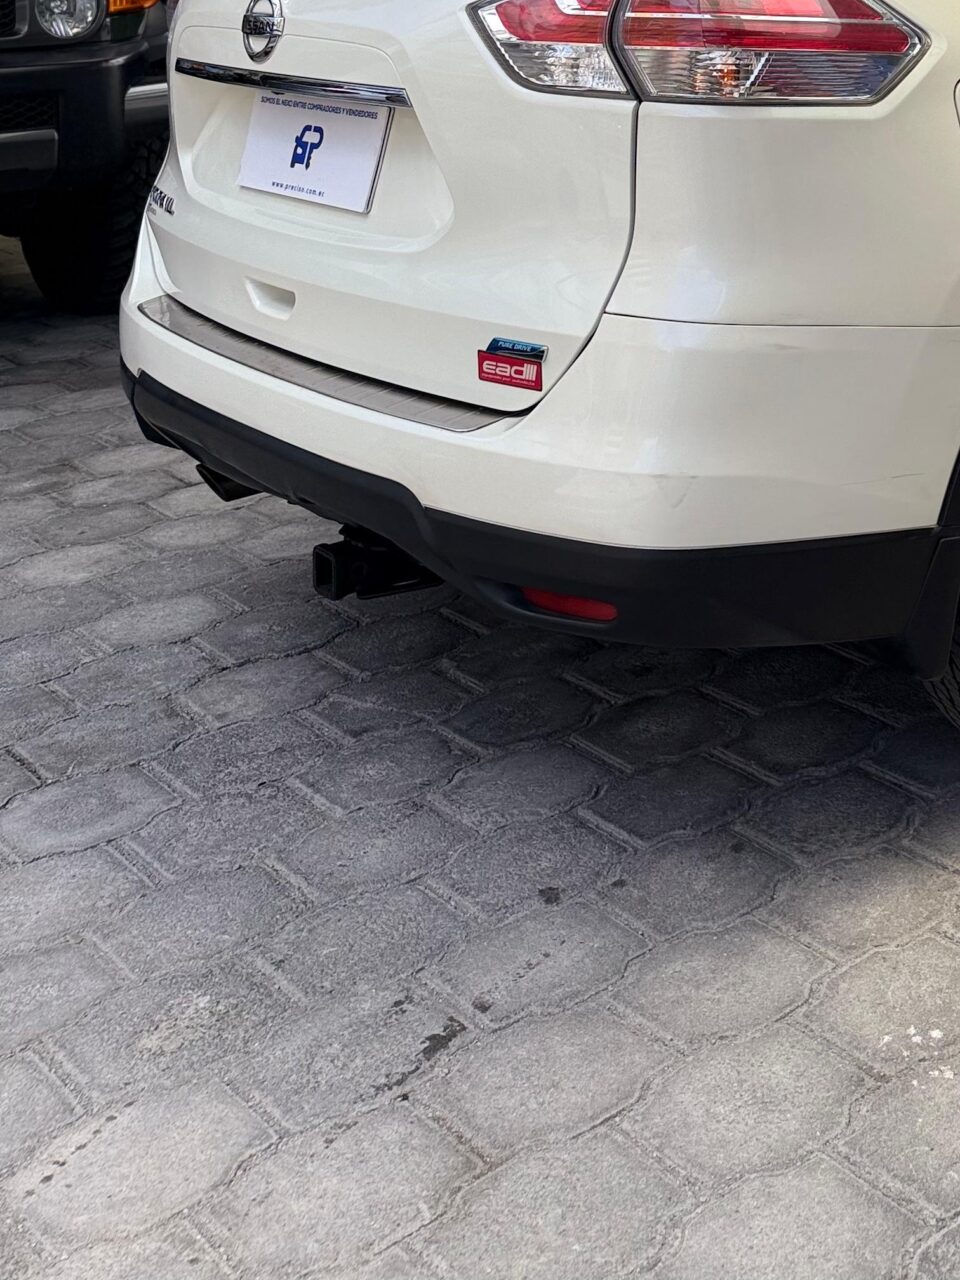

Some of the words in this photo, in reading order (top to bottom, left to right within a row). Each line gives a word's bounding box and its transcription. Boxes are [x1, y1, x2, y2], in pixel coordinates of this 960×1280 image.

[261, 96, 275, 105] SOMOS
[307, 102, 342, 115] COMPRADORES
[345, 107, 379, 120] VENDEDORES
[514, 343, 532, 352] DRIVE
